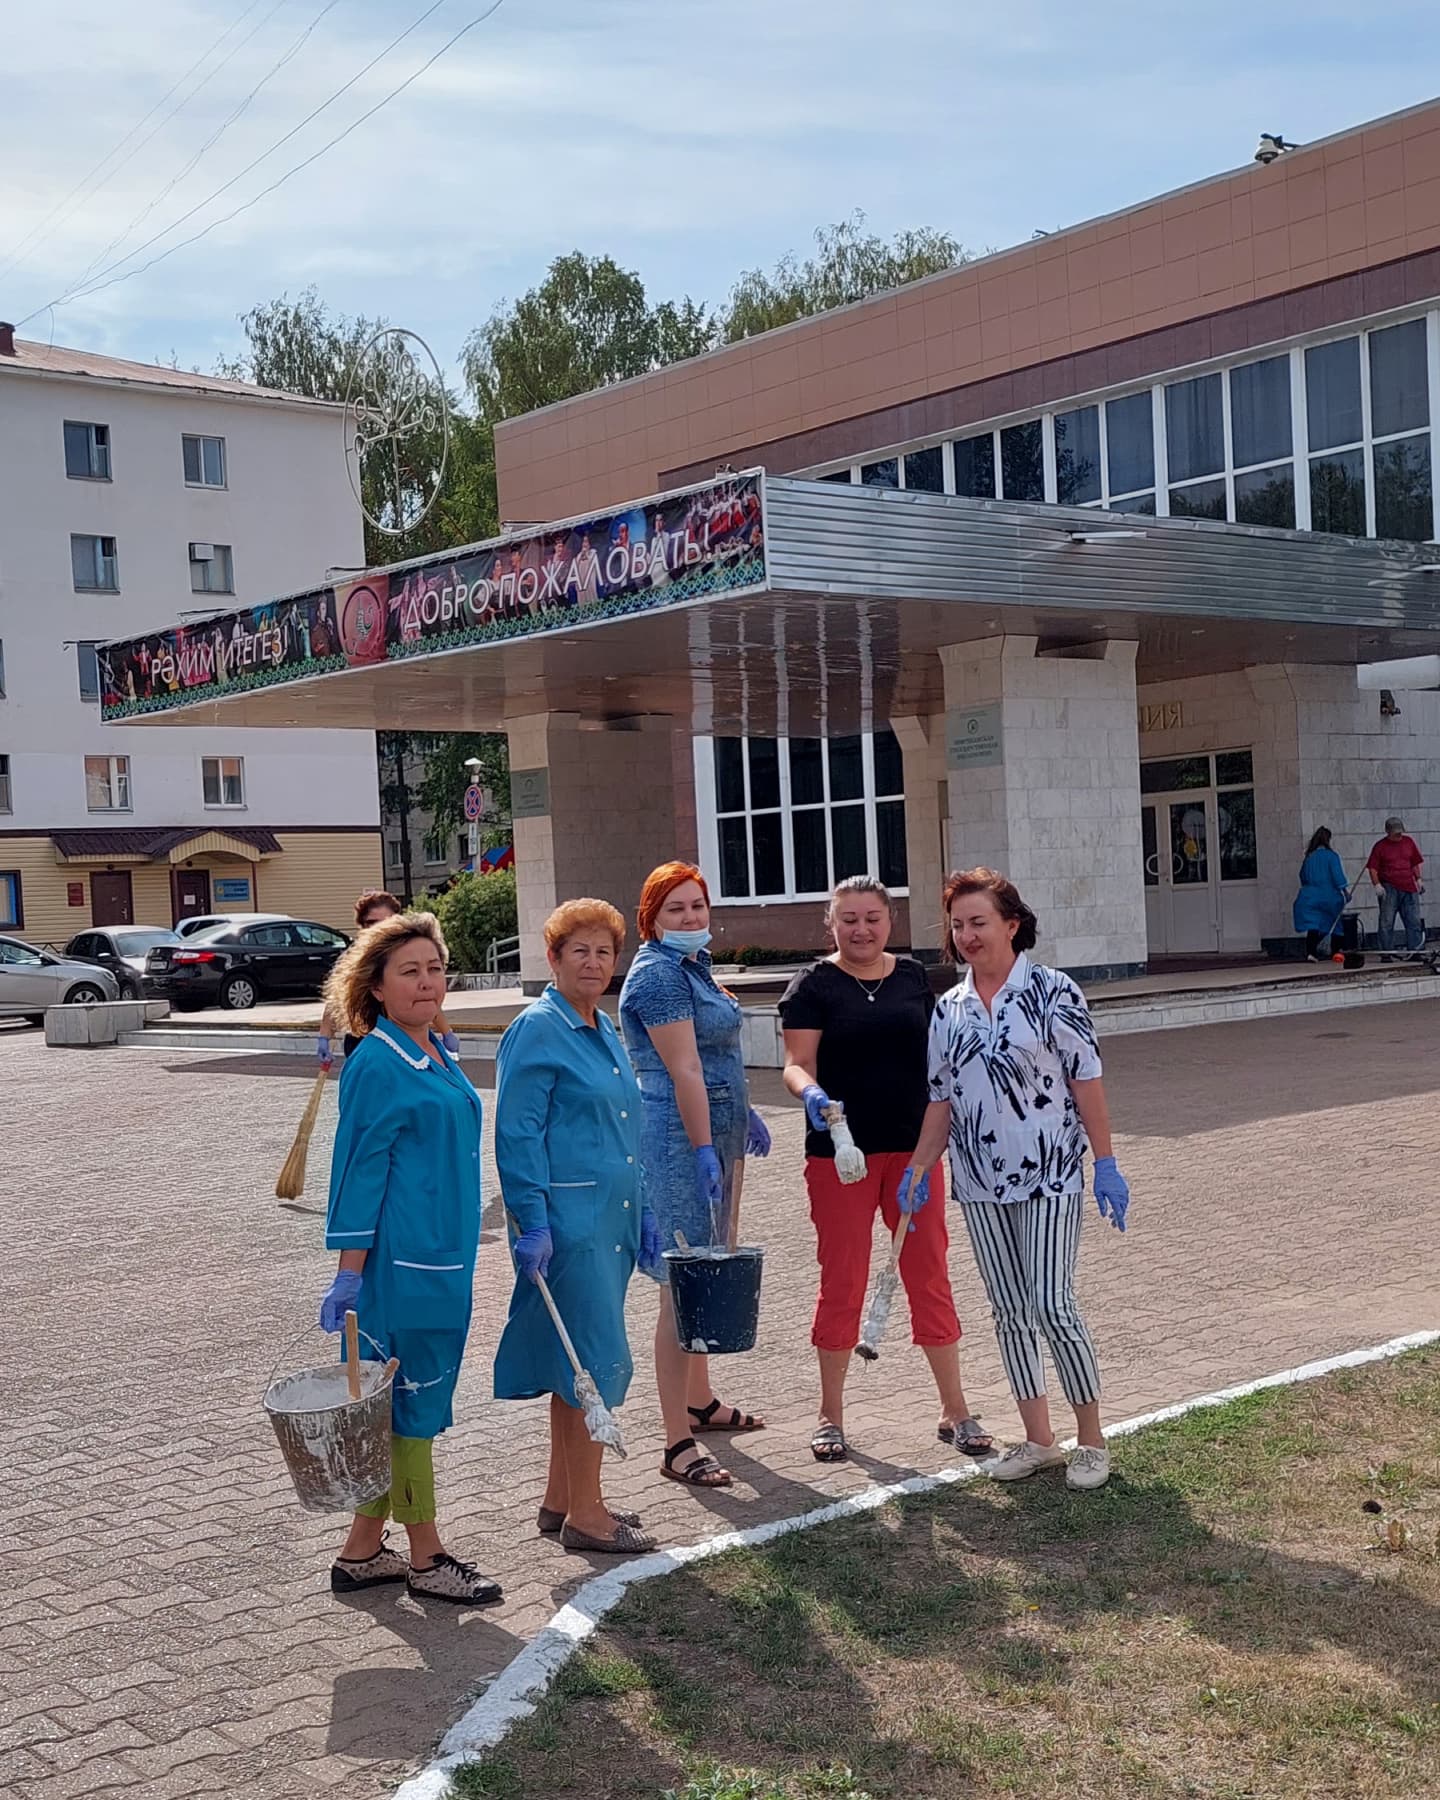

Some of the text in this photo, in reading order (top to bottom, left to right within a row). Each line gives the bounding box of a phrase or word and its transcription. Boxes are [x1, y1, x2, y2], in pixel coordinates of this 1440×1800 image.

[403, 522, 712, 633] ДОБРО ПОЖАЛОВАТЬ!
[151, 625, 288, 686] РӘХИМ ИТЕГЕЗ!
